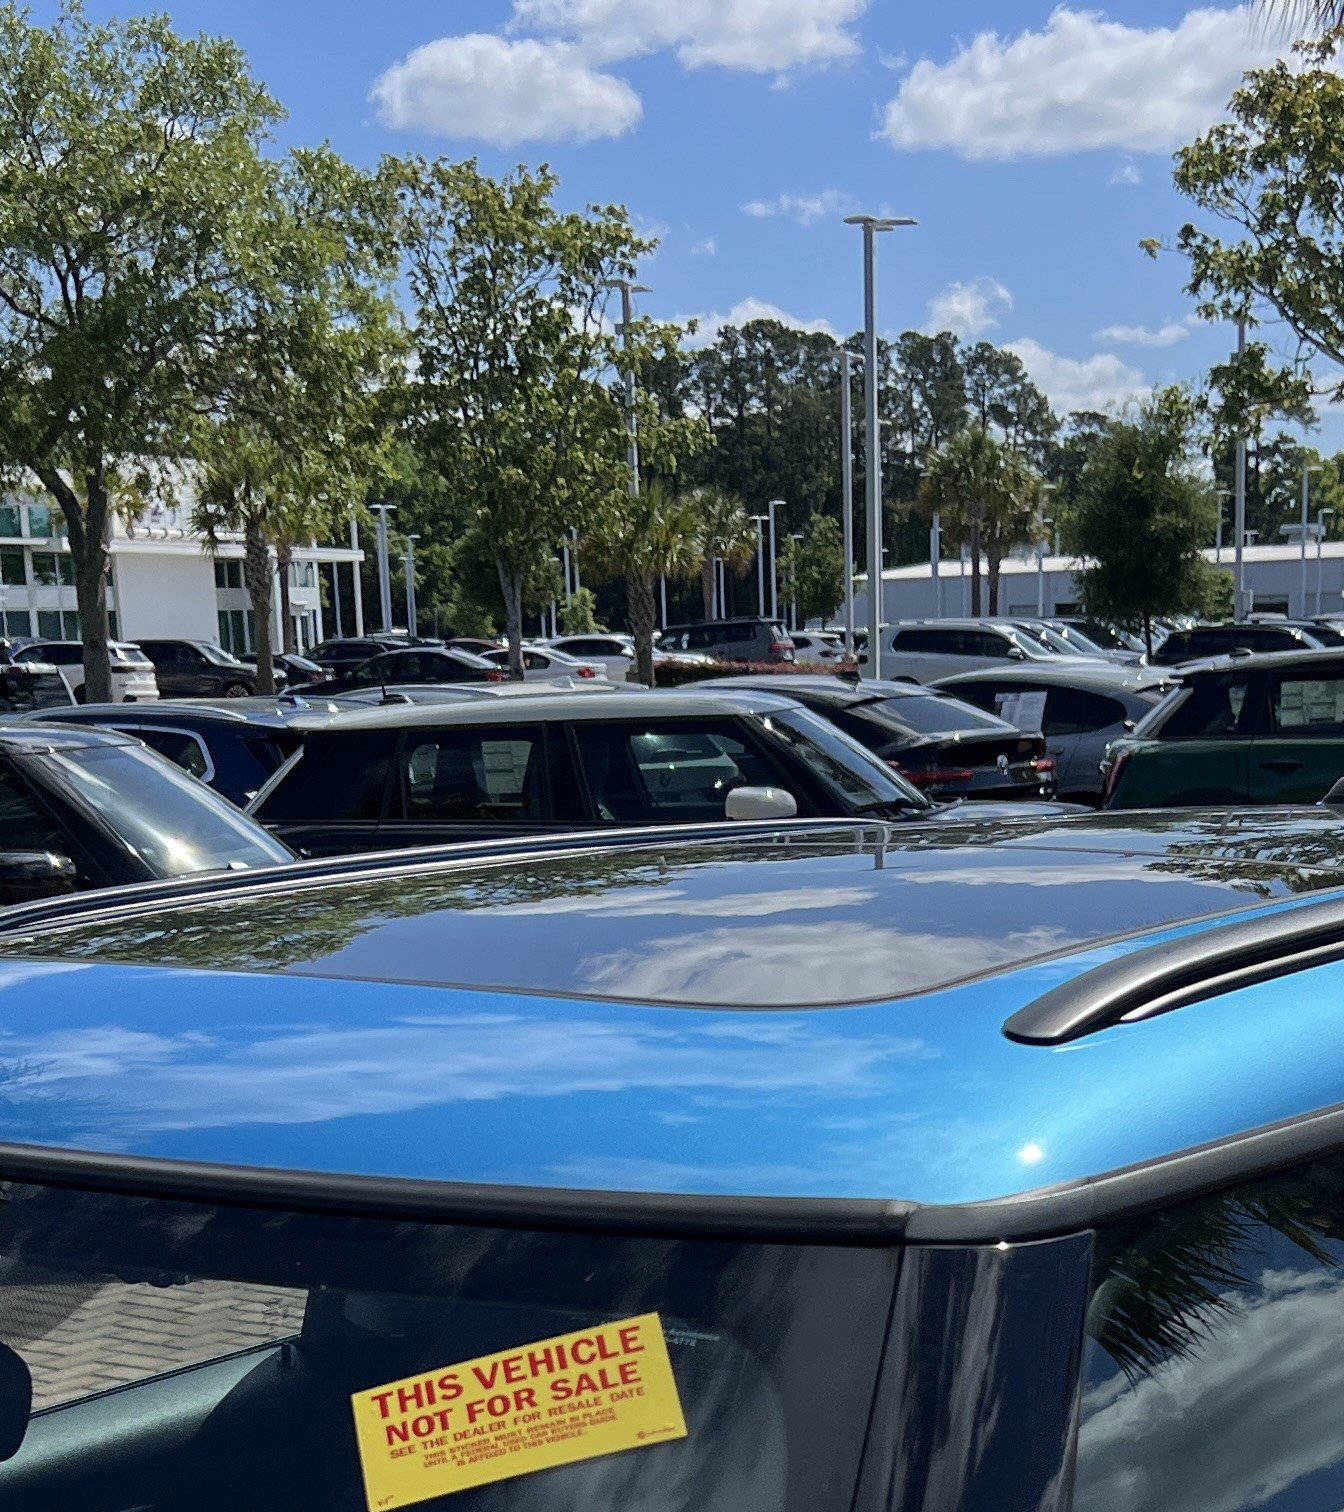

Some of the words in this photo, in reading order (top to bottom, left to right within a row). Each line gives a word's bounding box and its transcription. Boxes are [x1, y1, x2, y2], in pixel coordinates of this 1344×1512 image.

[371, 1374, 464, 1419] THIS
[472, 1325, 645, 1390] VEHICLE
[385, 1408, 453, 1446] NOT
[466, 1388, 538, 1424] FOR
[550, 1361, 641, 1401] SALE
[390, 1444, 417, 1459] SEE
[422, 1435, 448, 1450] THE
[453, 1420, 506, 1442] DEALER
[513, 1411, 541, 1426] FOR
[548, 1396, 603, 1417] RESALE
[609, 1386, 645, 1403] DATE
